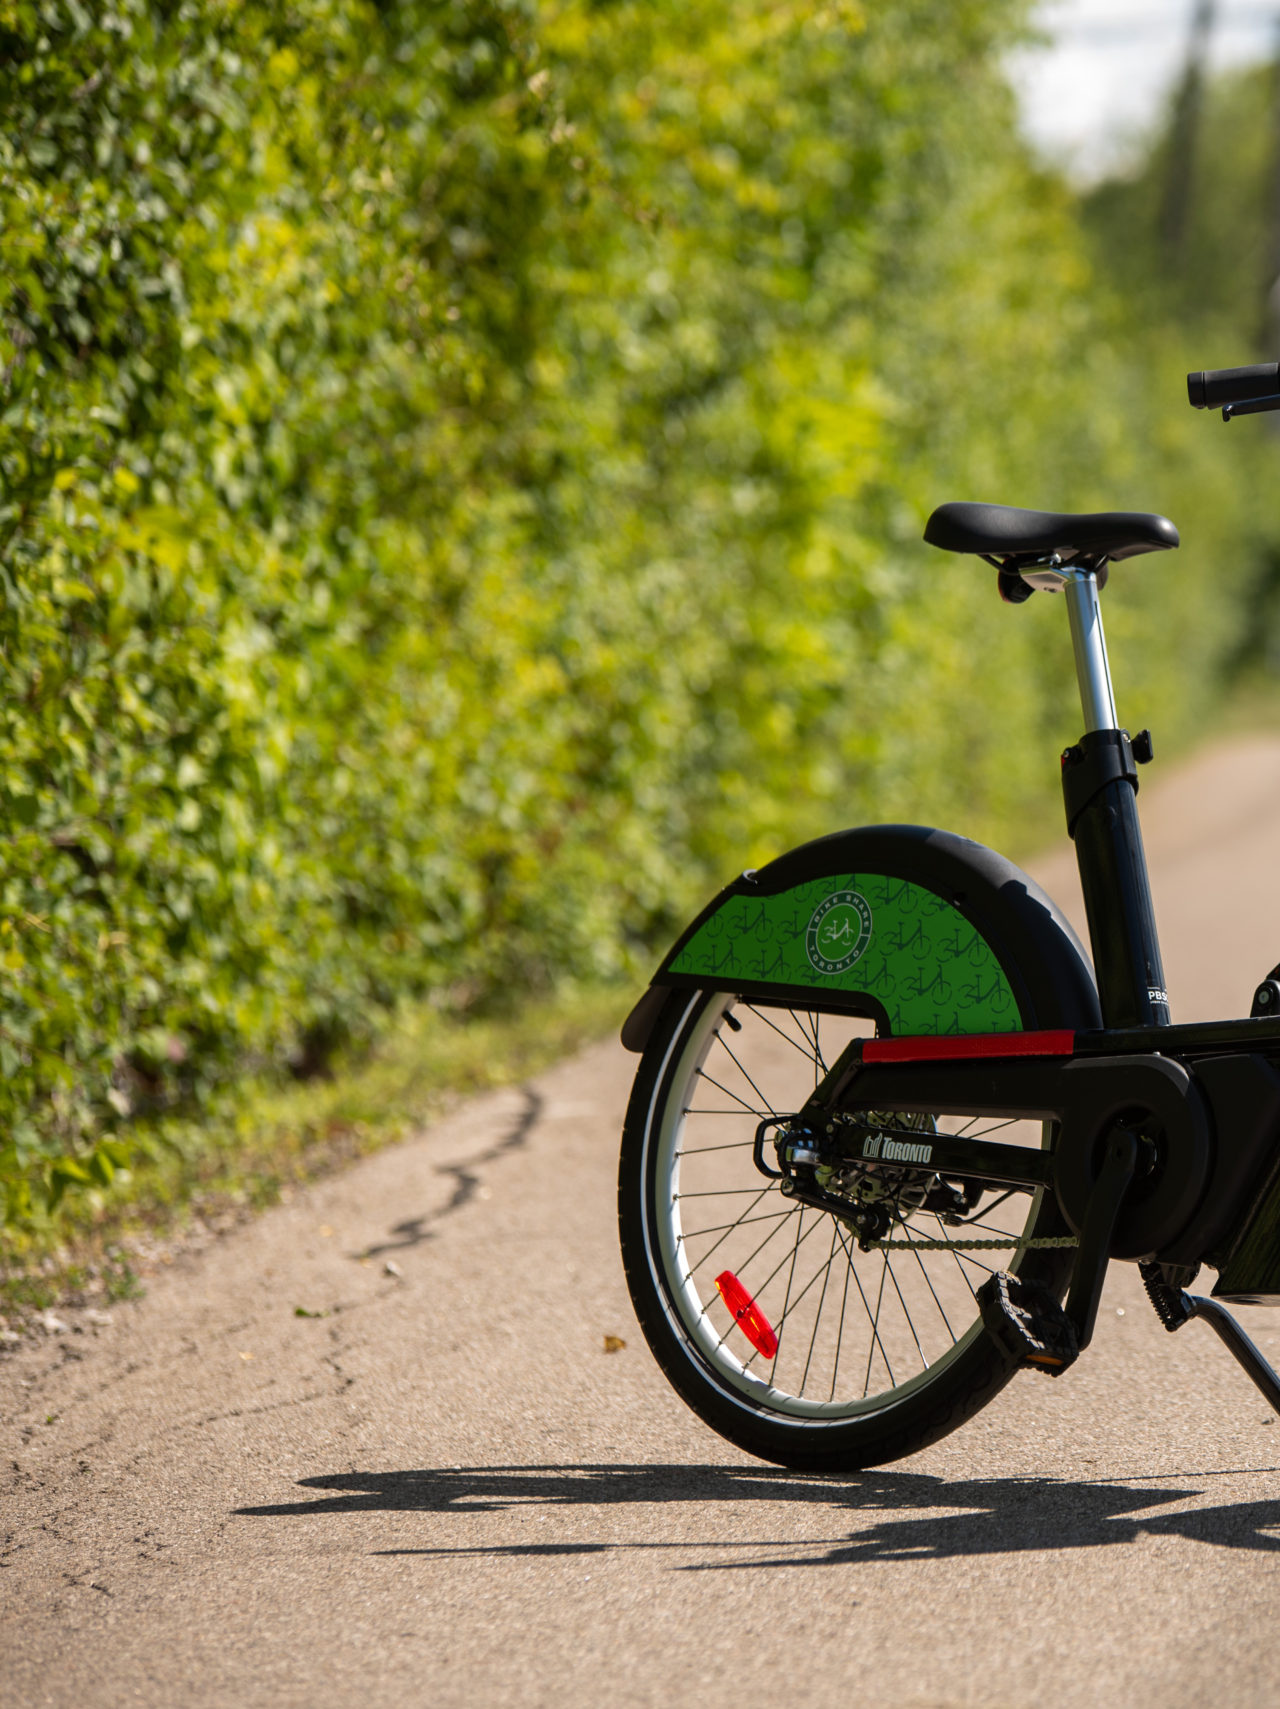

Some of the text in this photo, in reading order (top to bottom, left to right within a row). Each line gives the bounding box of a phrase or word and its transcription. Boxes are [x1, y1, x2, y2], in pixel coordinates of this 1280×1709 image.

[814, 895, 869, 927] BIKE SHARE
[810, 945, 860, 971] TORONTO
[881, 1136, 933, 1164] TORONTO
